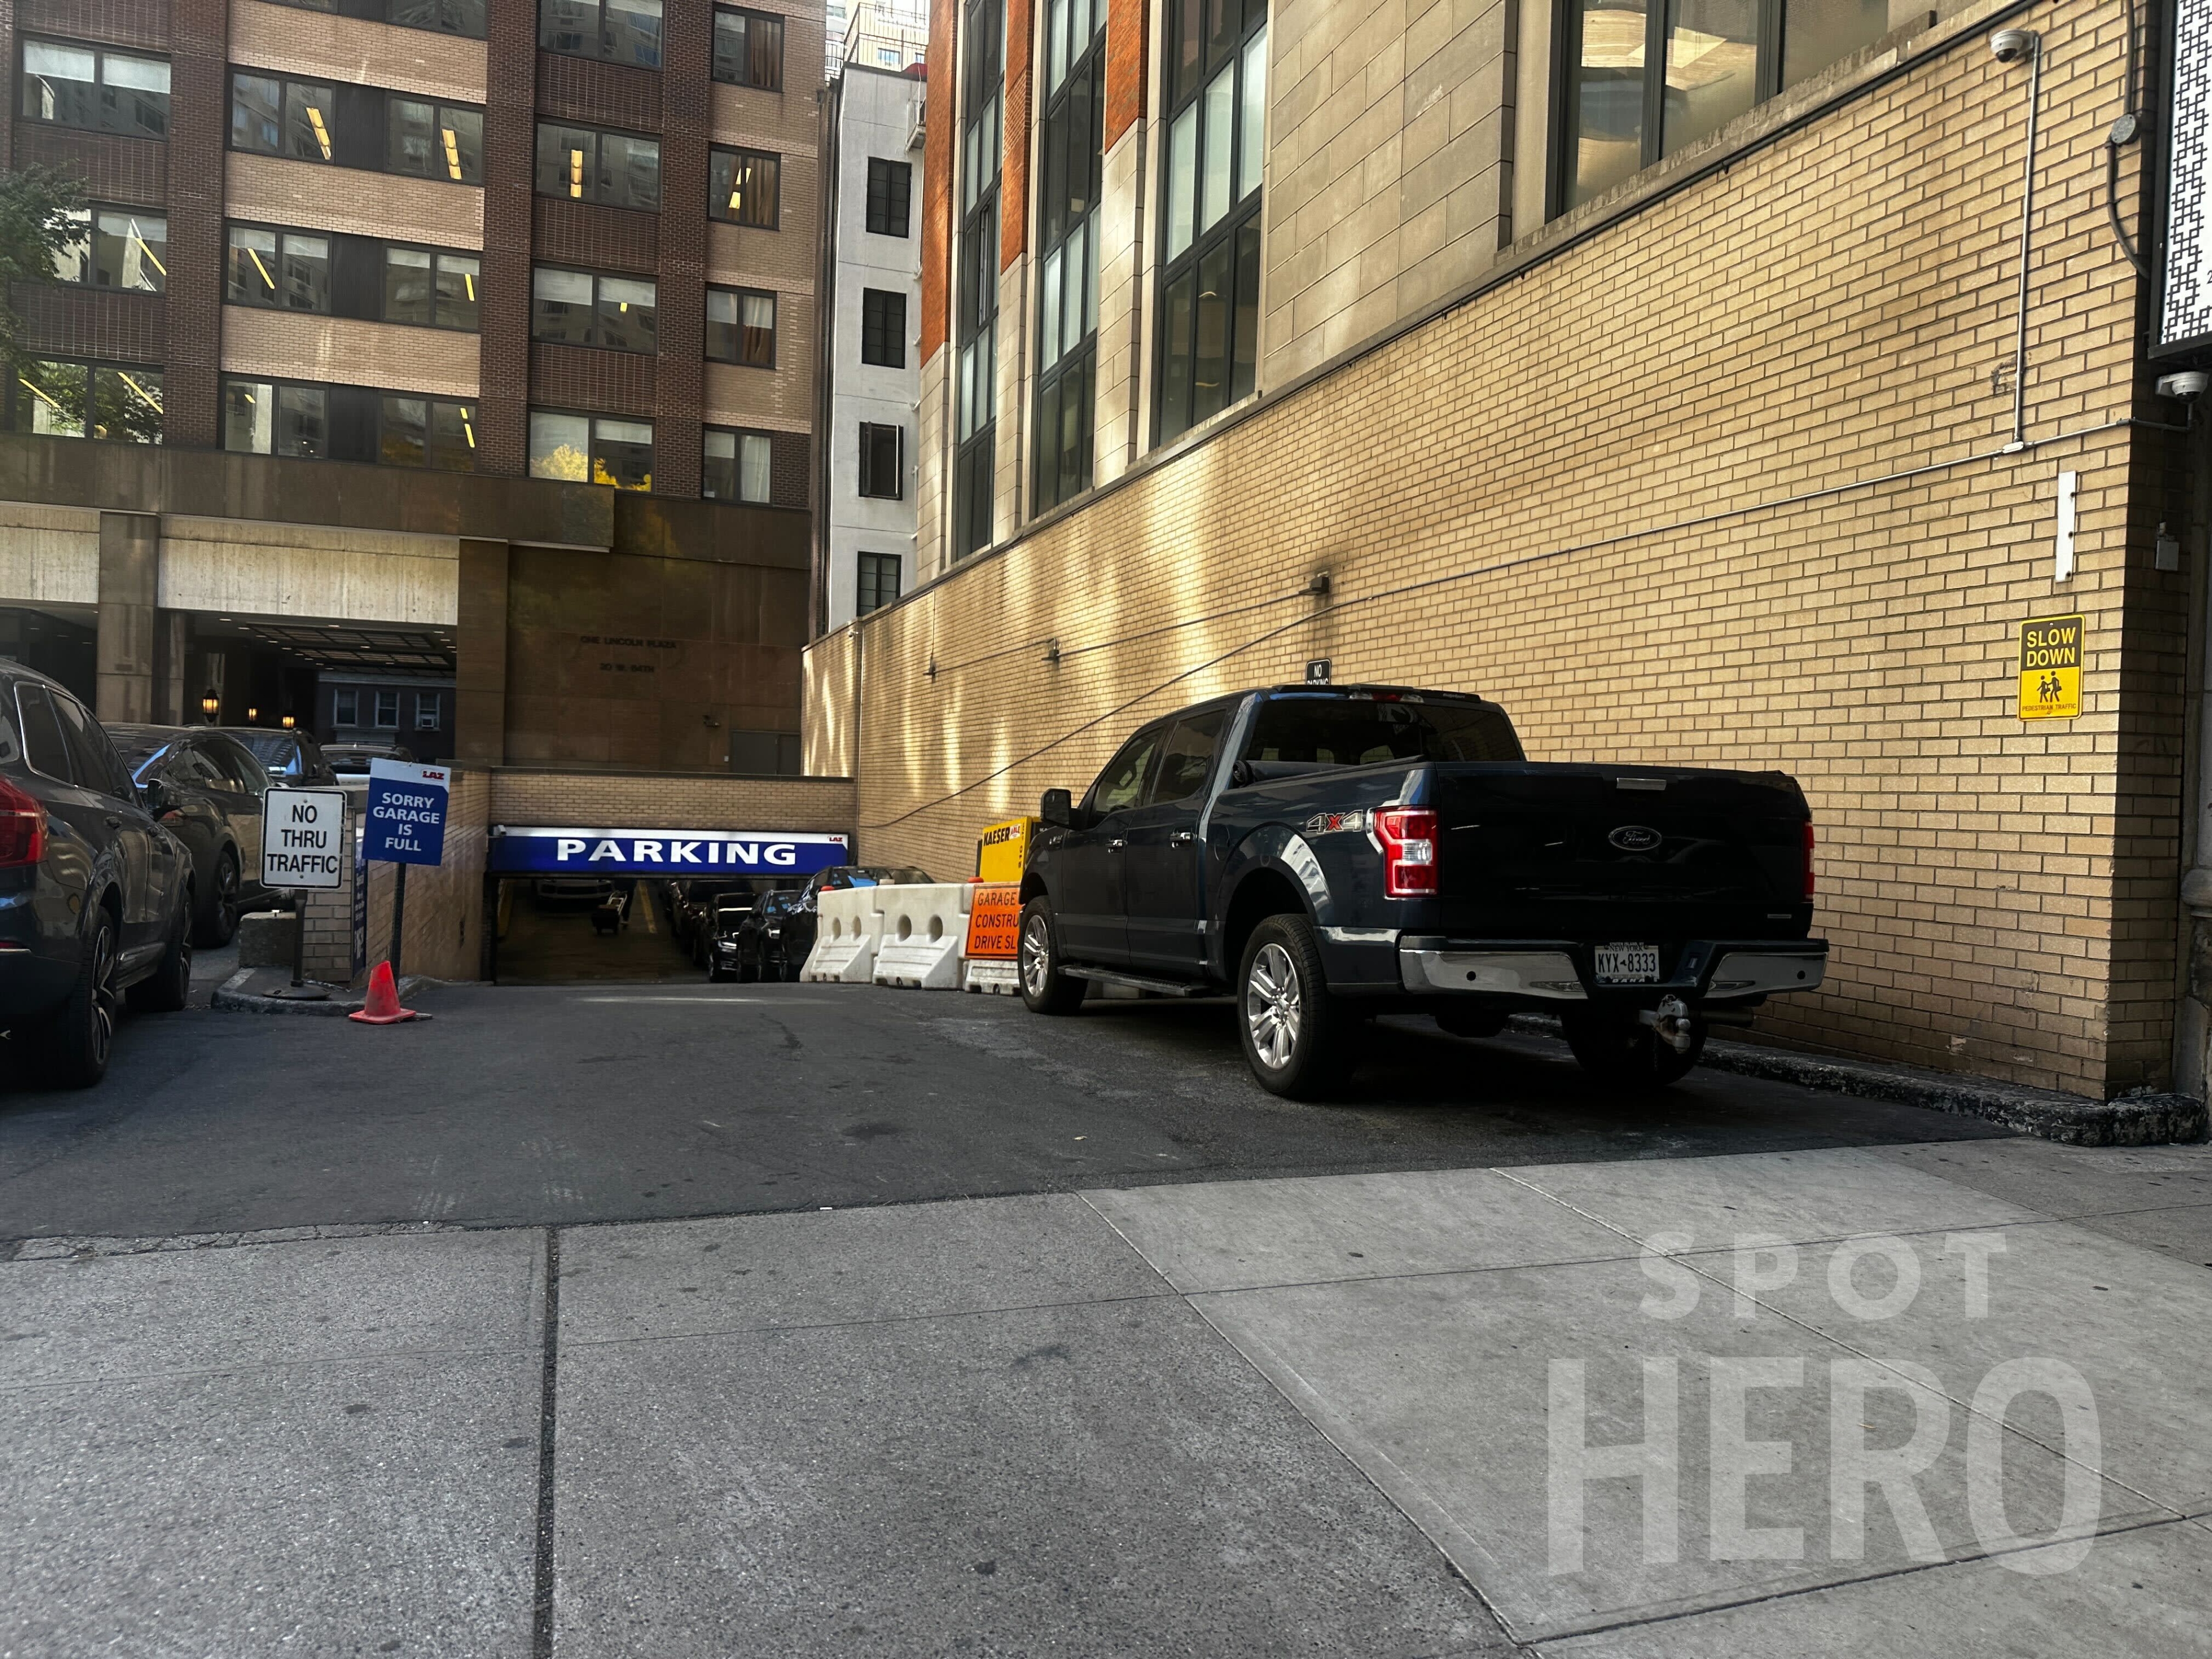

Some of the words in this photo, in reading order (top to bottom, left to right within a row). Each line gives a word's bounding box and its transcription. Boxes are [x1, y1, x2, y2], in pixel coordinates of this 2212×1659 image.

[580, 636, 601, 644] ONE
[605, 637, 643, 647] LINCOLN
[647, 639, 677, 649] PLAZA
[2027, 627, 2076, 647] SLOW
[2027, 647, 2075, 667] DOWN
[1314, 664, 1322, 678] NO
[422, 771, 445, 780] LAZ
[381, 792, 435, 809] SORRY
[291, 805, 318, 824] NO
[372, 806, 440, 824] GARAGE
[398, 824, 412, 836] IS
[983, 827, 1010, 846] KAESER
[1011, 825, 1020, 834] ABLE
[281, 830, 327, 849] THRU
[384, 837, 422, 852] FULL
[1623, 831, 1650, 844] Ford
[557, 839, 796, 865] PARKING
[267, 854, 338, 874] TRAFFIC
[978, 892, 1017, 906] GARAGE
[975, 914, 1018, 928] CONSTRU
[974, 935, 1002, 949] DRIVE
[1005, 935, 1016, 949] SL
